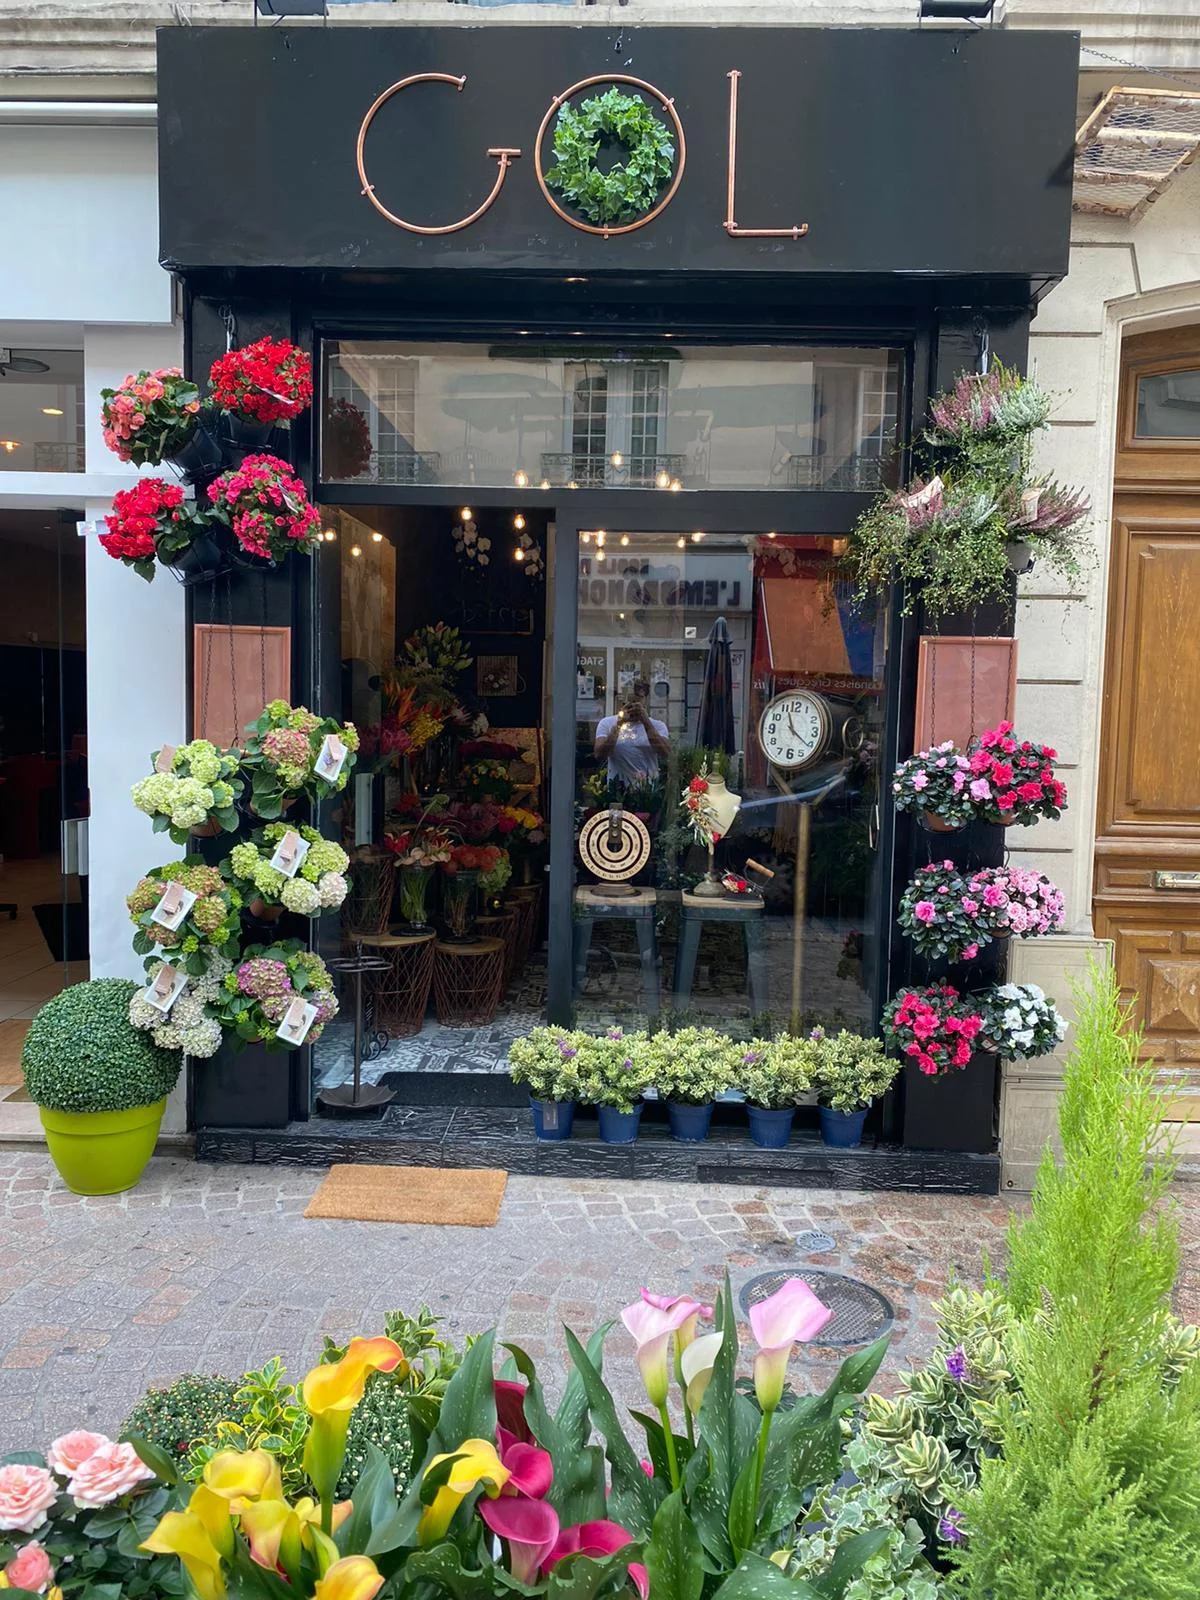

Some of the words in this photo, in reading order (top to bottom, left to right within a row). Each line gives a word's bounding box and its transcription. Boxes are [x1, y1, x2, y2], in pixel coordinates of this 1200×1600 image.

[356, 70, 809, 239] GOL
[781, 704, 789, 712] 11
[790, 701, 802, 713] 12
[772, 713, 782, 721] 10
[810, 716, 817, 724] 2
[768, 723, 776, 734] 9
[811, 727, 819, 738] 3
[770, 737, 777, 745] 8
[776, 747, 783, 755] 7
[786, 748, 794, 760] 6
[798, 749, 805, 757] 5
